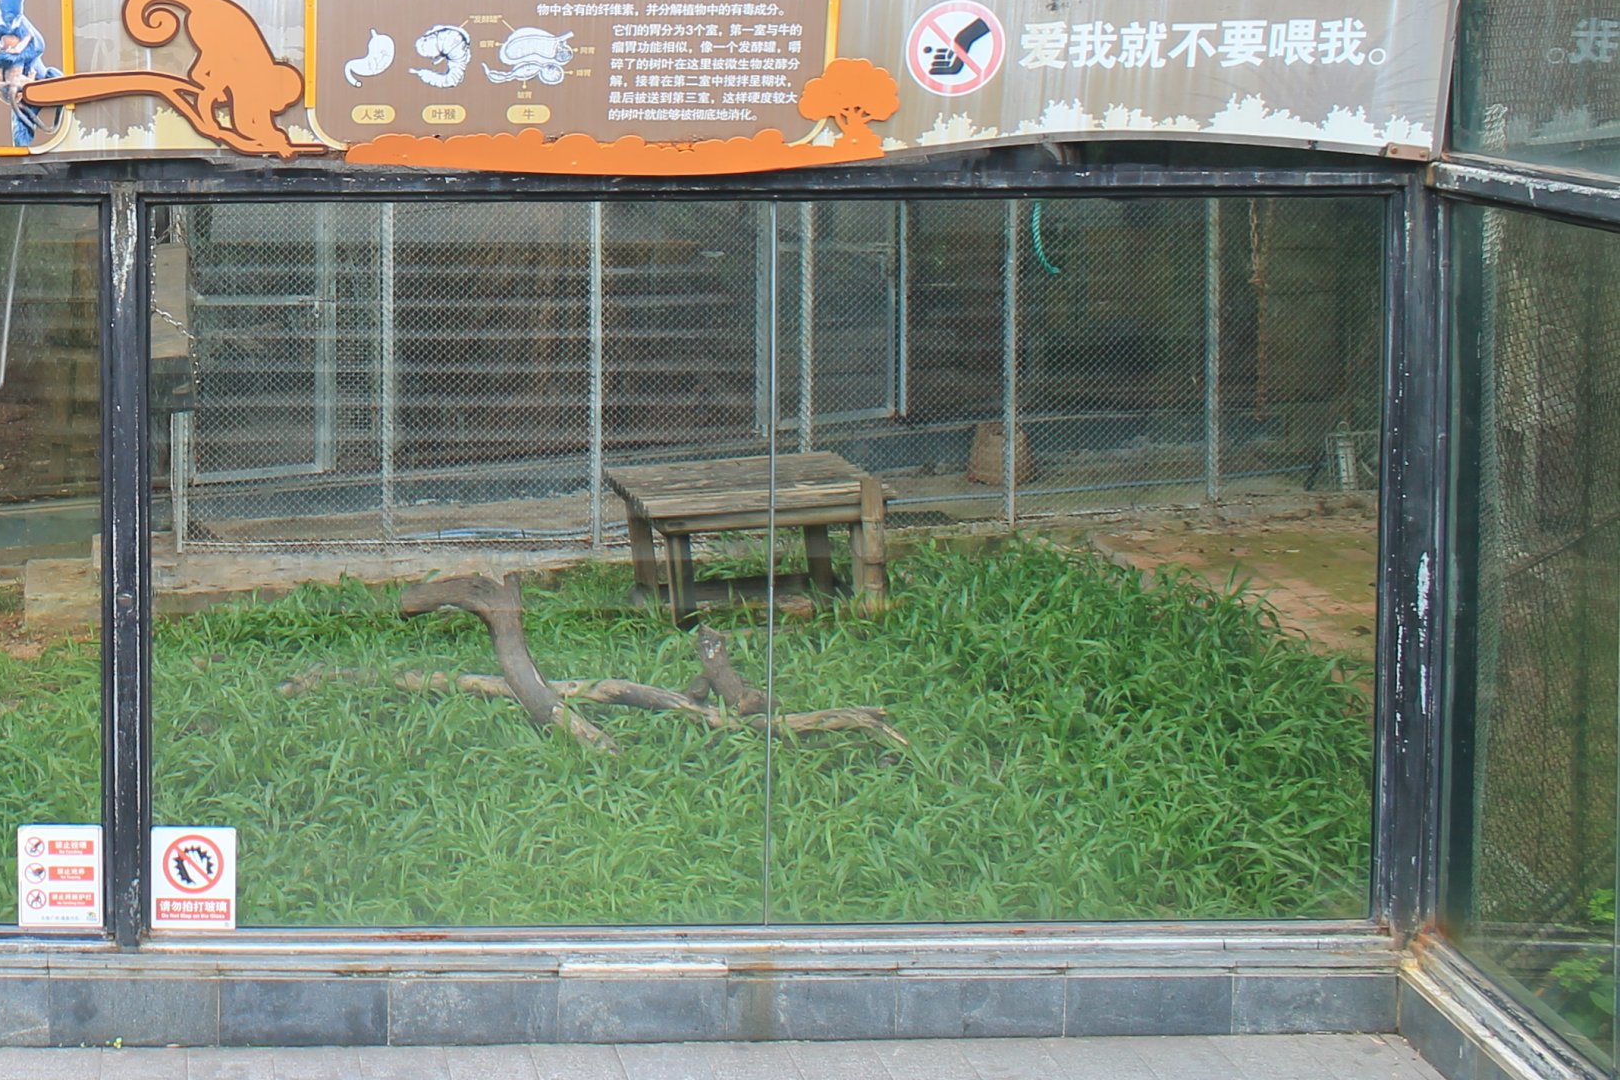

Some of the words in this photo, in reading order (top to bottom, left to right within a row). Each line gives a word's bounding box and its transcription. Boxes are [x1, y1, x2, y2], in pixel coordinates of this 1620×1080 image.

[536, 3, 785, 16] 物中含有的纤维素，并分解植物中的有毒成分。
[612, 24, 803, 37] 它们的胃分为3个室，第一室与牛的
[1018, 18, 1387, 70] 爱我就不要喂我。
[610, 58, 801, 70] 碎了的树叶在这里被微生物发酵分
[609, 92, 798, 104] 最后被送到第三室，这样硬度较大
[360, 108, 386, 121] 人类
[431, 108, 457, 121] 叶猴
[522, 108, 535, 121] 牛
[608, 109, 758, 121] 的树叶就能够被彻底地消化。
[160, 901, 227, 913] 请勿拍打玻璃
